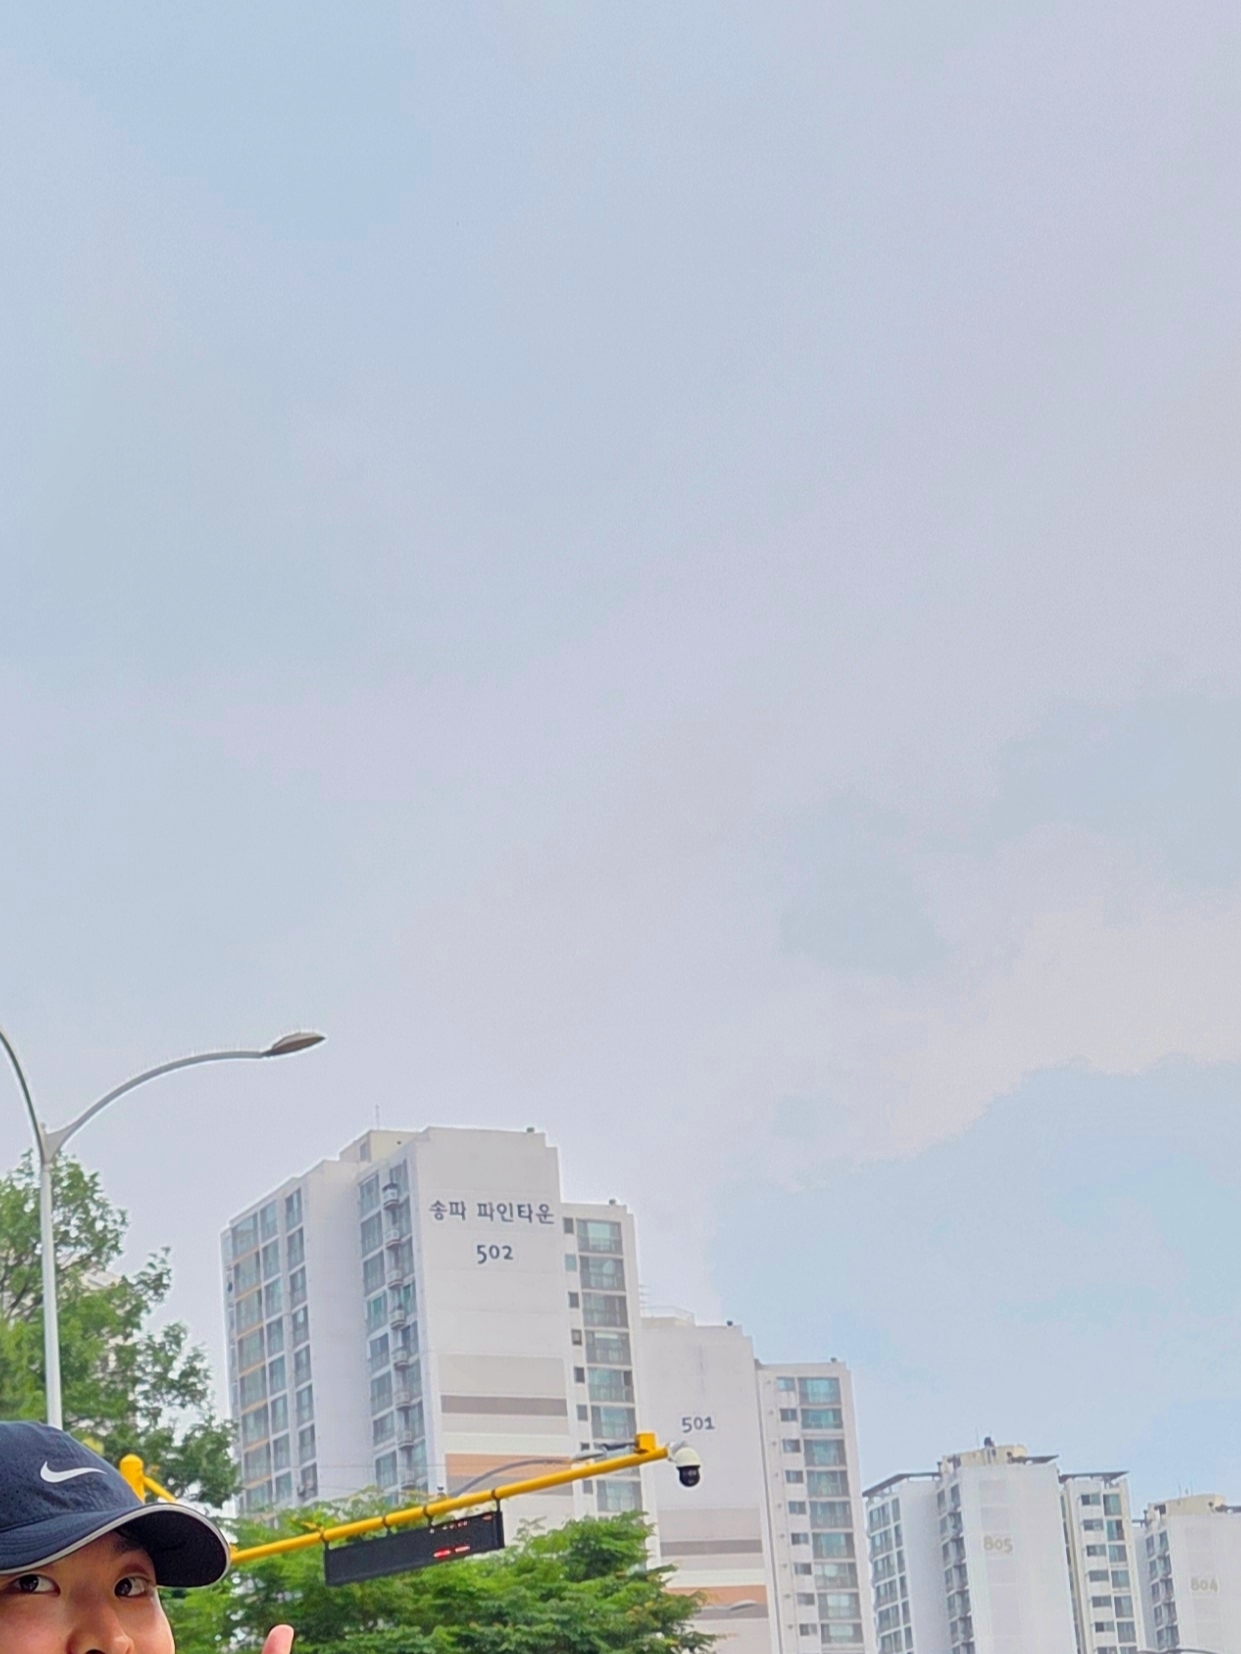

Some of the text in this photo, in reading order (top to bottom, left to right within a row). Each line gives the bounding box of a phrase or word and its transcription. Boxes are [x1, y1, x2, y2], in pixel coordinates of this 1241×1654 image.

[428, 1199, 555, 1225] 송파 파인타운
[475, 1243, 514, 1264] 502
[681, 1415, 715, 1433] 501
[982, 1534, 1013, 1554] 805
[1190, 1576, 1219, 1593] 804
